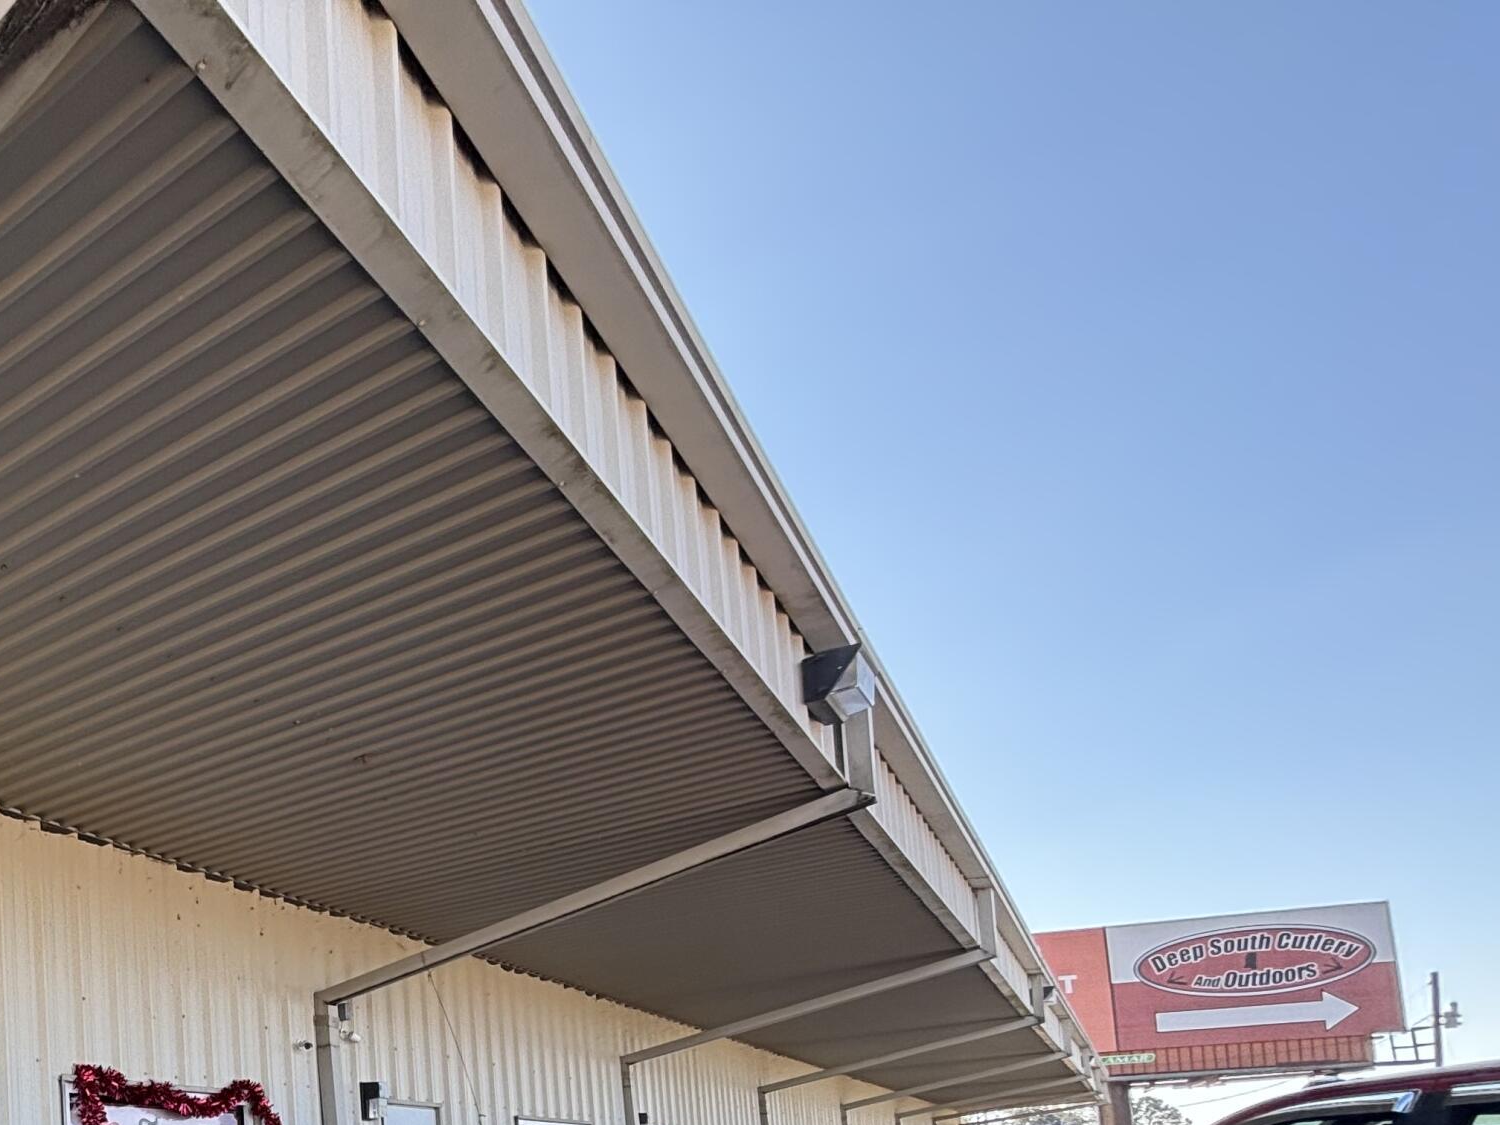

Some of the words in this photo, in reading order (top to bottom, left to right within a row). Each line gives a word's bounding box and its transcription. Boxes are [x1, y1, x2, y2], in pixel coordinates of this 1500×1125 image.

[1150, 946, 1206, 974] Deep
[1207, 932, 1272, 956] South
[1276, 930, 1362, 960] Cutlery
[1192, 974, 1222, 989] And
[1222, 961, 1318, 989] Outdoors
